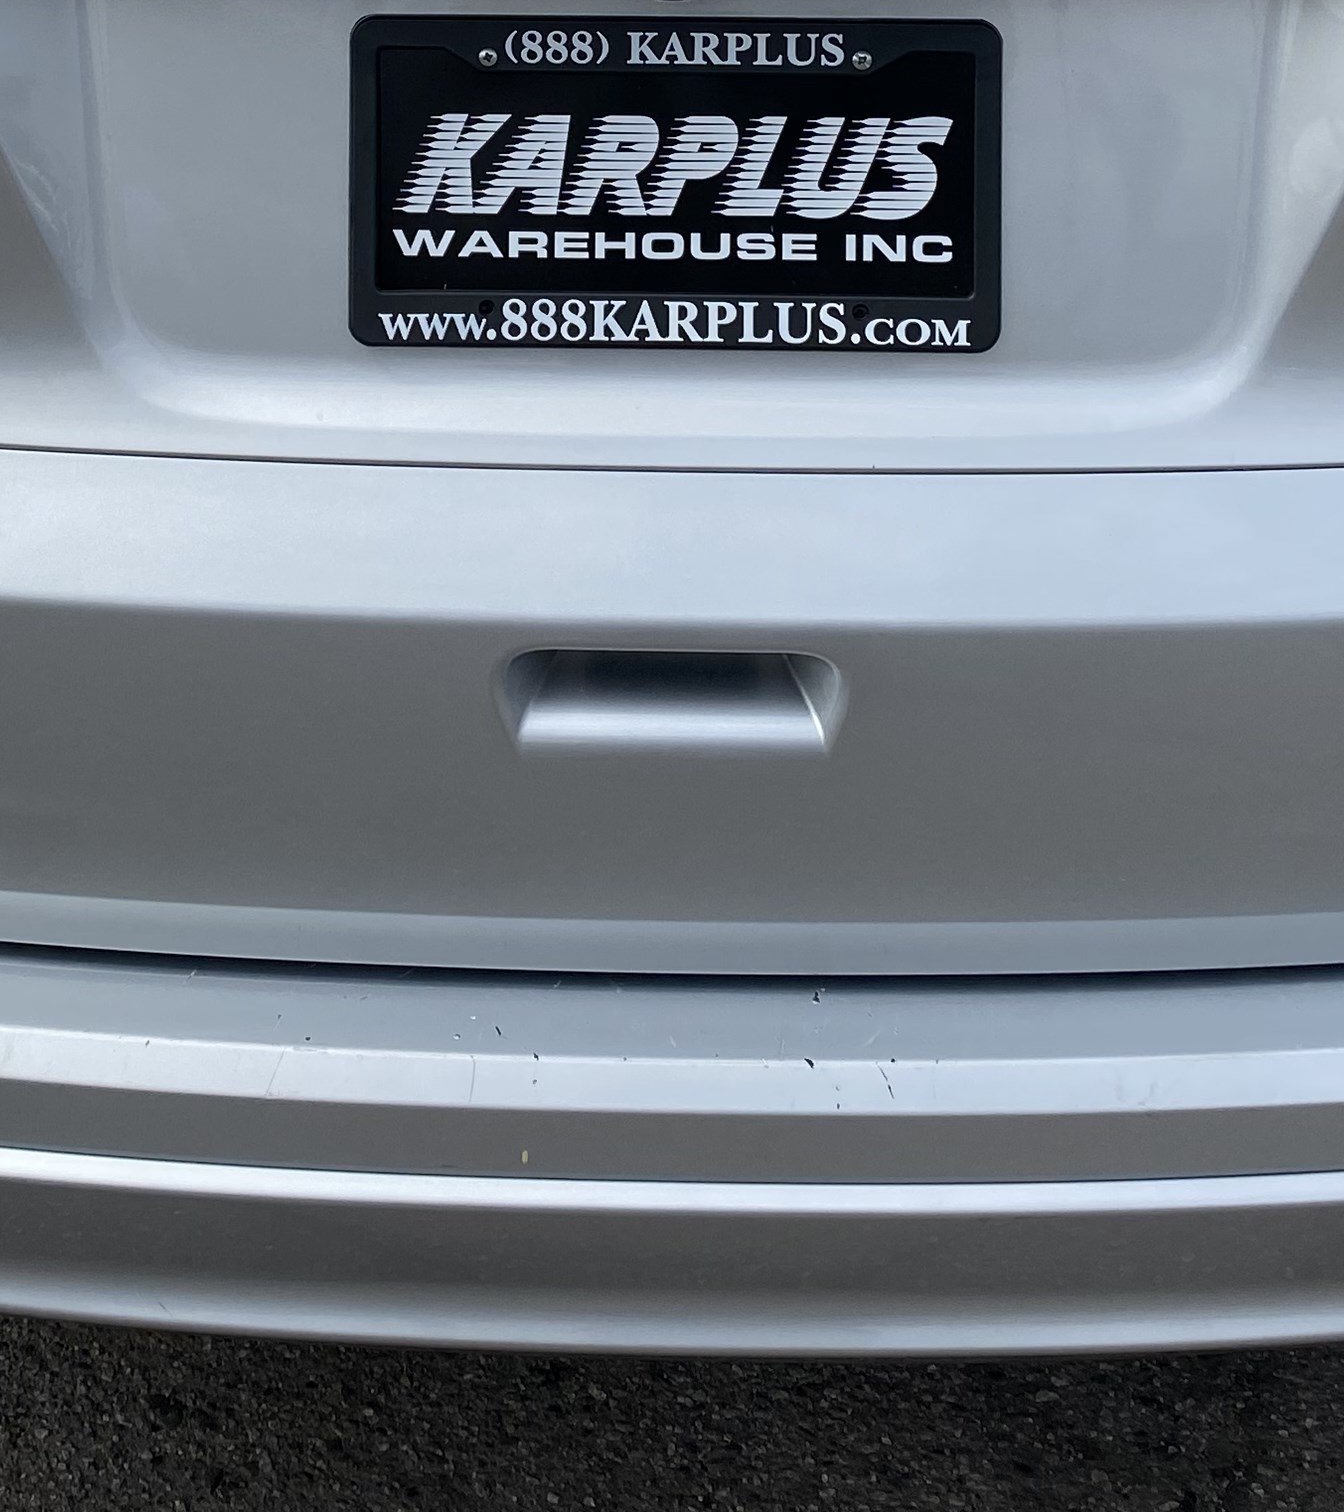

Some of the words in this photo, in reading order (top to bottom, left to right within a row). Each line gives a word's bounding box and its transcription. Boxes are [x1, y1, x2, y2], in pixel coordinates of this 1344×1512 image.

[504, 30, 610, 67] (888)
[627, 32, 845, 67] KARPLUS
[392, 112, 955, 220] KARPLUS
[392, 228, 818, 262] WAREHOUSE
[845, 234, 954, 263] INC
